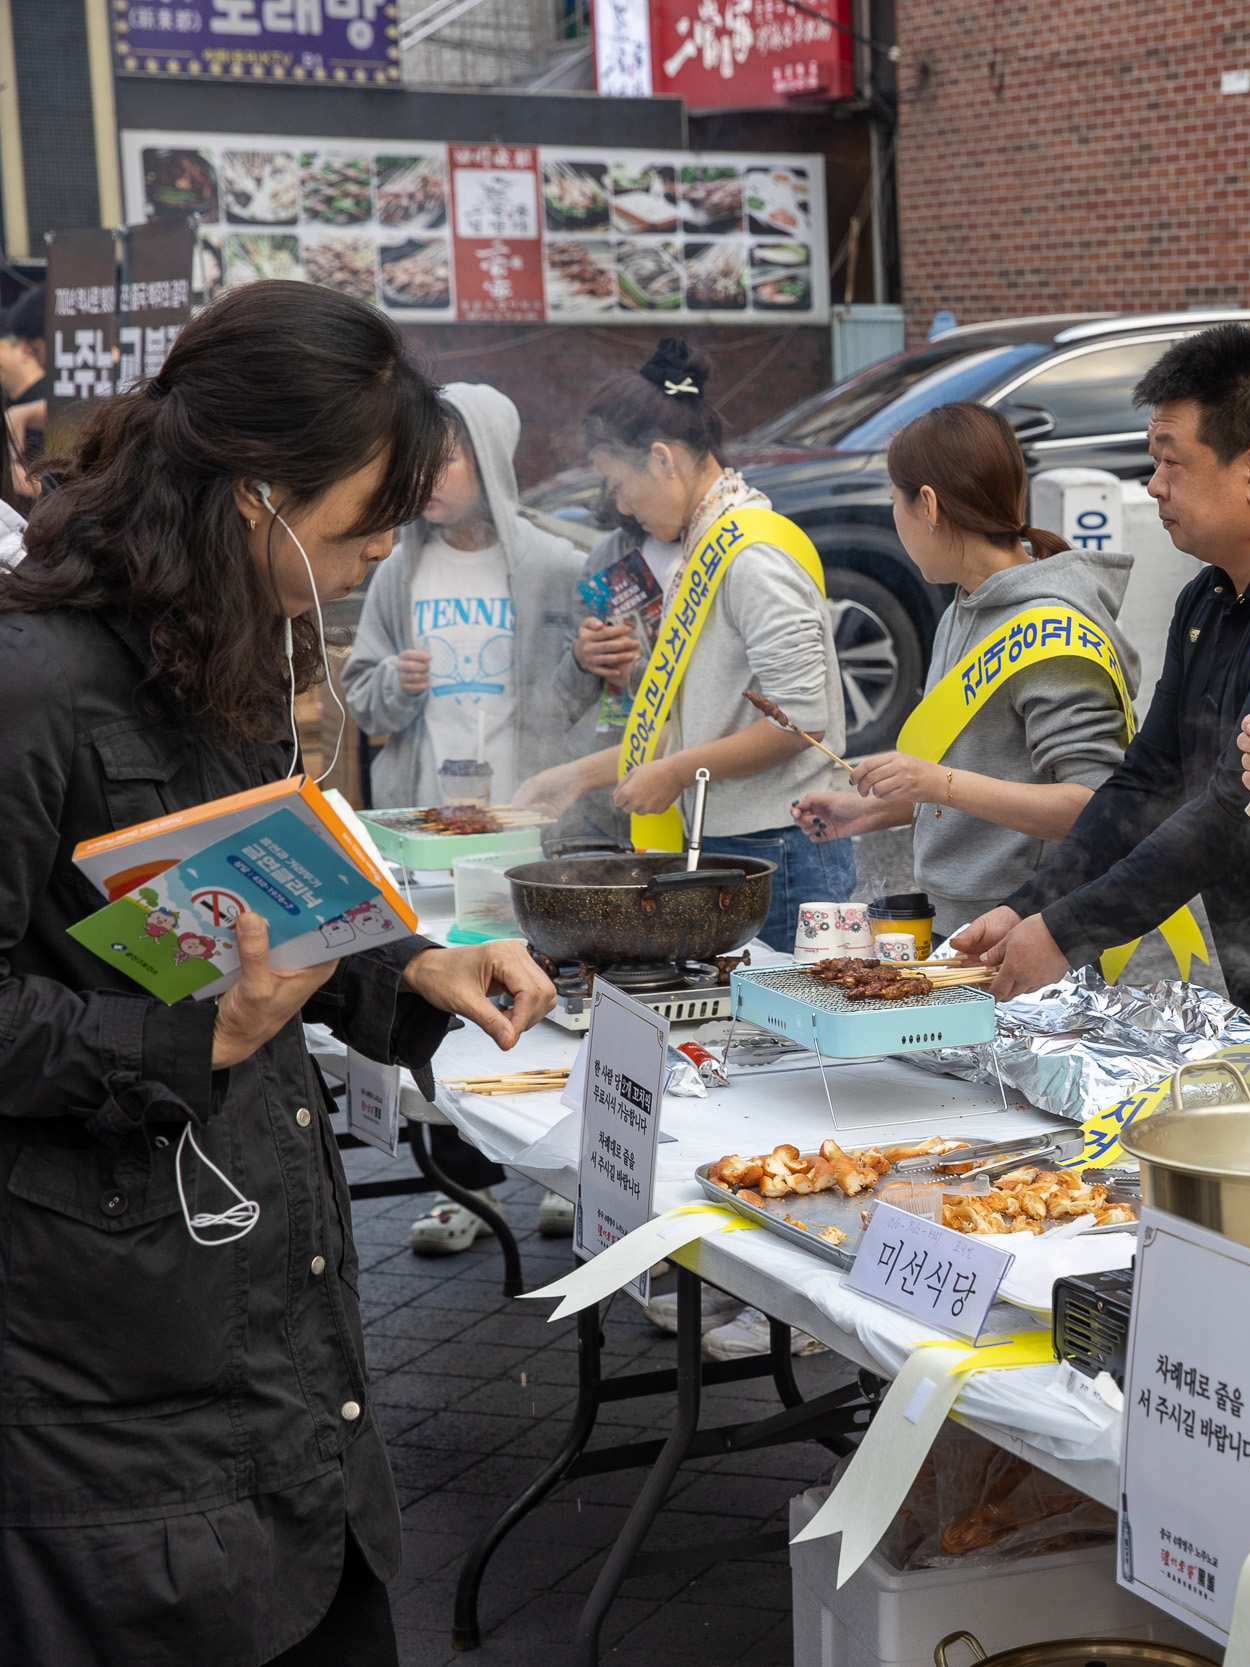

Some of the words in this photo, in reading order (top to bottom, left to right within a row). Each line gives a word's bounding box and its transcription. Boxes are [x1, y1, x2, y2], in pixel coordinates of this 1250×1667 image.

[242, 845, 323, 909] 금연클리닉
[594, 1059, 601, 1078] 한
[601, 1065, 614, 1086] 사람
[615, 1073, 622, 1092] 당
[621, 1079, 632, 1100] 2개
[593, 1084, 617, 1115] 무료시식
[617, 1101, 647, 1136] 가능합니다
[591, 1151, 597, 1169] 서
[598, 1156, 615, 1182] 주시길
[617, 1169, 640, 1201] 바랍니다
[598, 1131, 622, 1159] 차례대로
[623, 1148, 635, 1171] 줄을
[877, 1239, 977, 1317] 미선식당
[1156, 1354, 1210, 1401] 차례대로
[1215, 1381, 1244, 1418] 줄을
[1138, 1388, 1151, 1418] 서
[1155, 1396, 1196, 1439] 주시길
[1160, 1527, 1171, 1543] 중국
[1195, 1547, 1218, 1568] 노주노교
